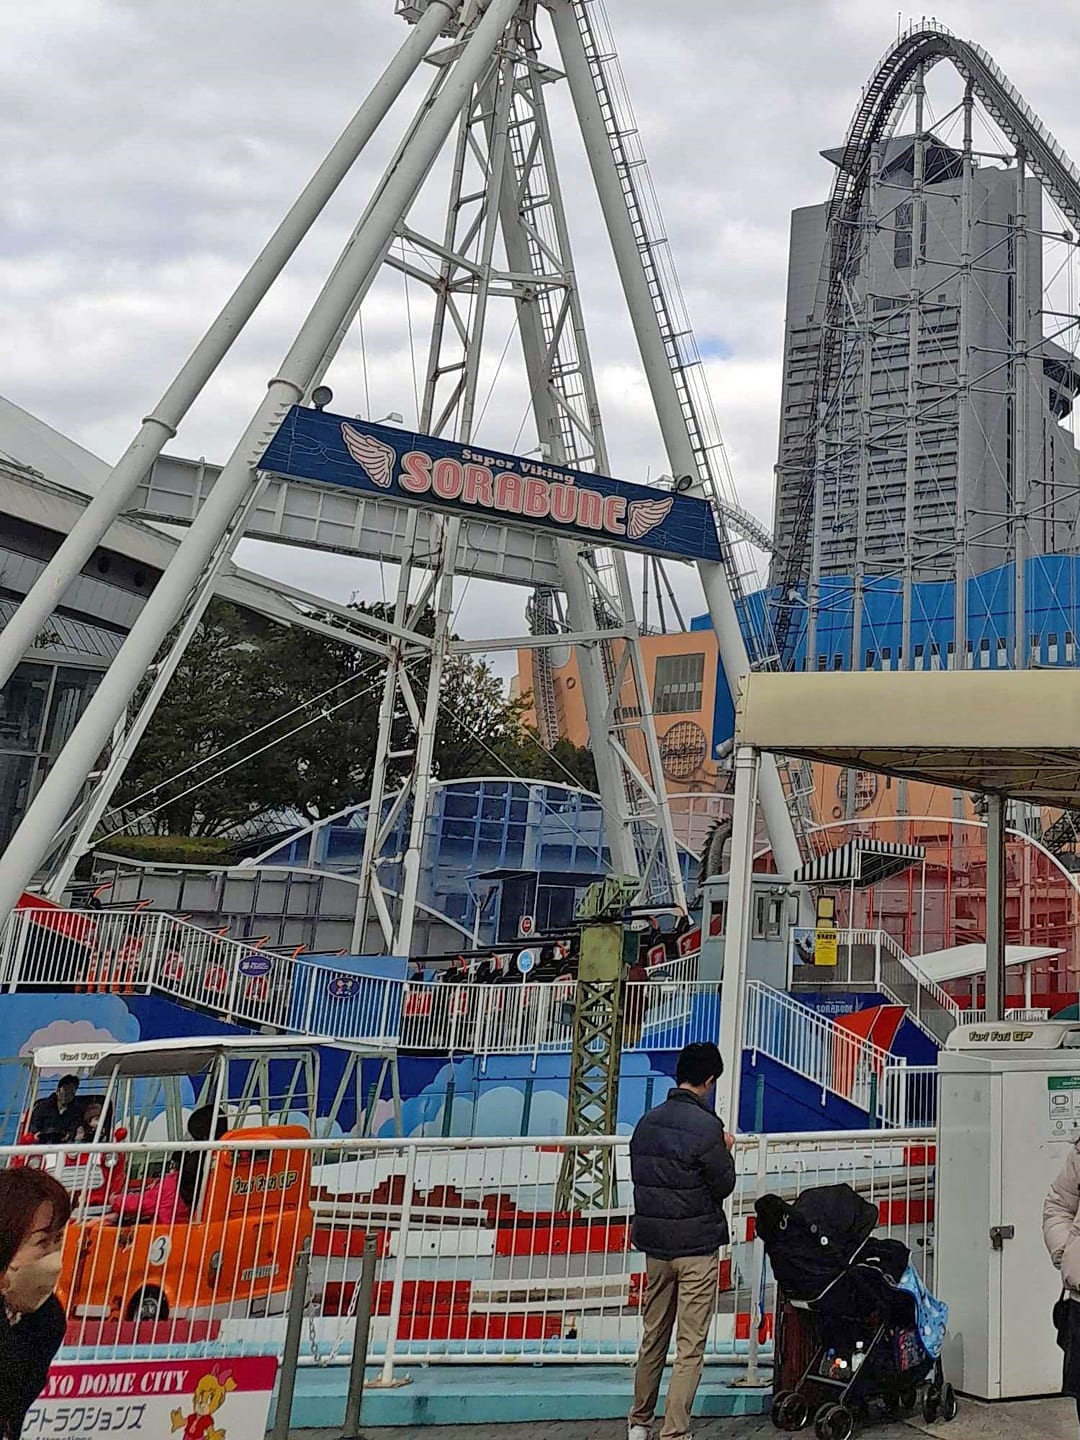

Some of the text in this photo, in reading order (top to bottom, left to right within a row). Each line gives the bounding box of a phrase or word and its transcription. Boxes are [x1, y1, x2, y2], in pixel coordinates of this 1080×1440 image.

[462, 449, 576, 485] Super Viking
[399, 450, 627, 535] SORABUNE
[1013, 1031, 1034, 1042] GP
[153, 1237, 167, 1263] 3
[46, 1369, 189, 1397] YO DOME CITY
[23, 1403, 147, 1433] アトラクションズ
